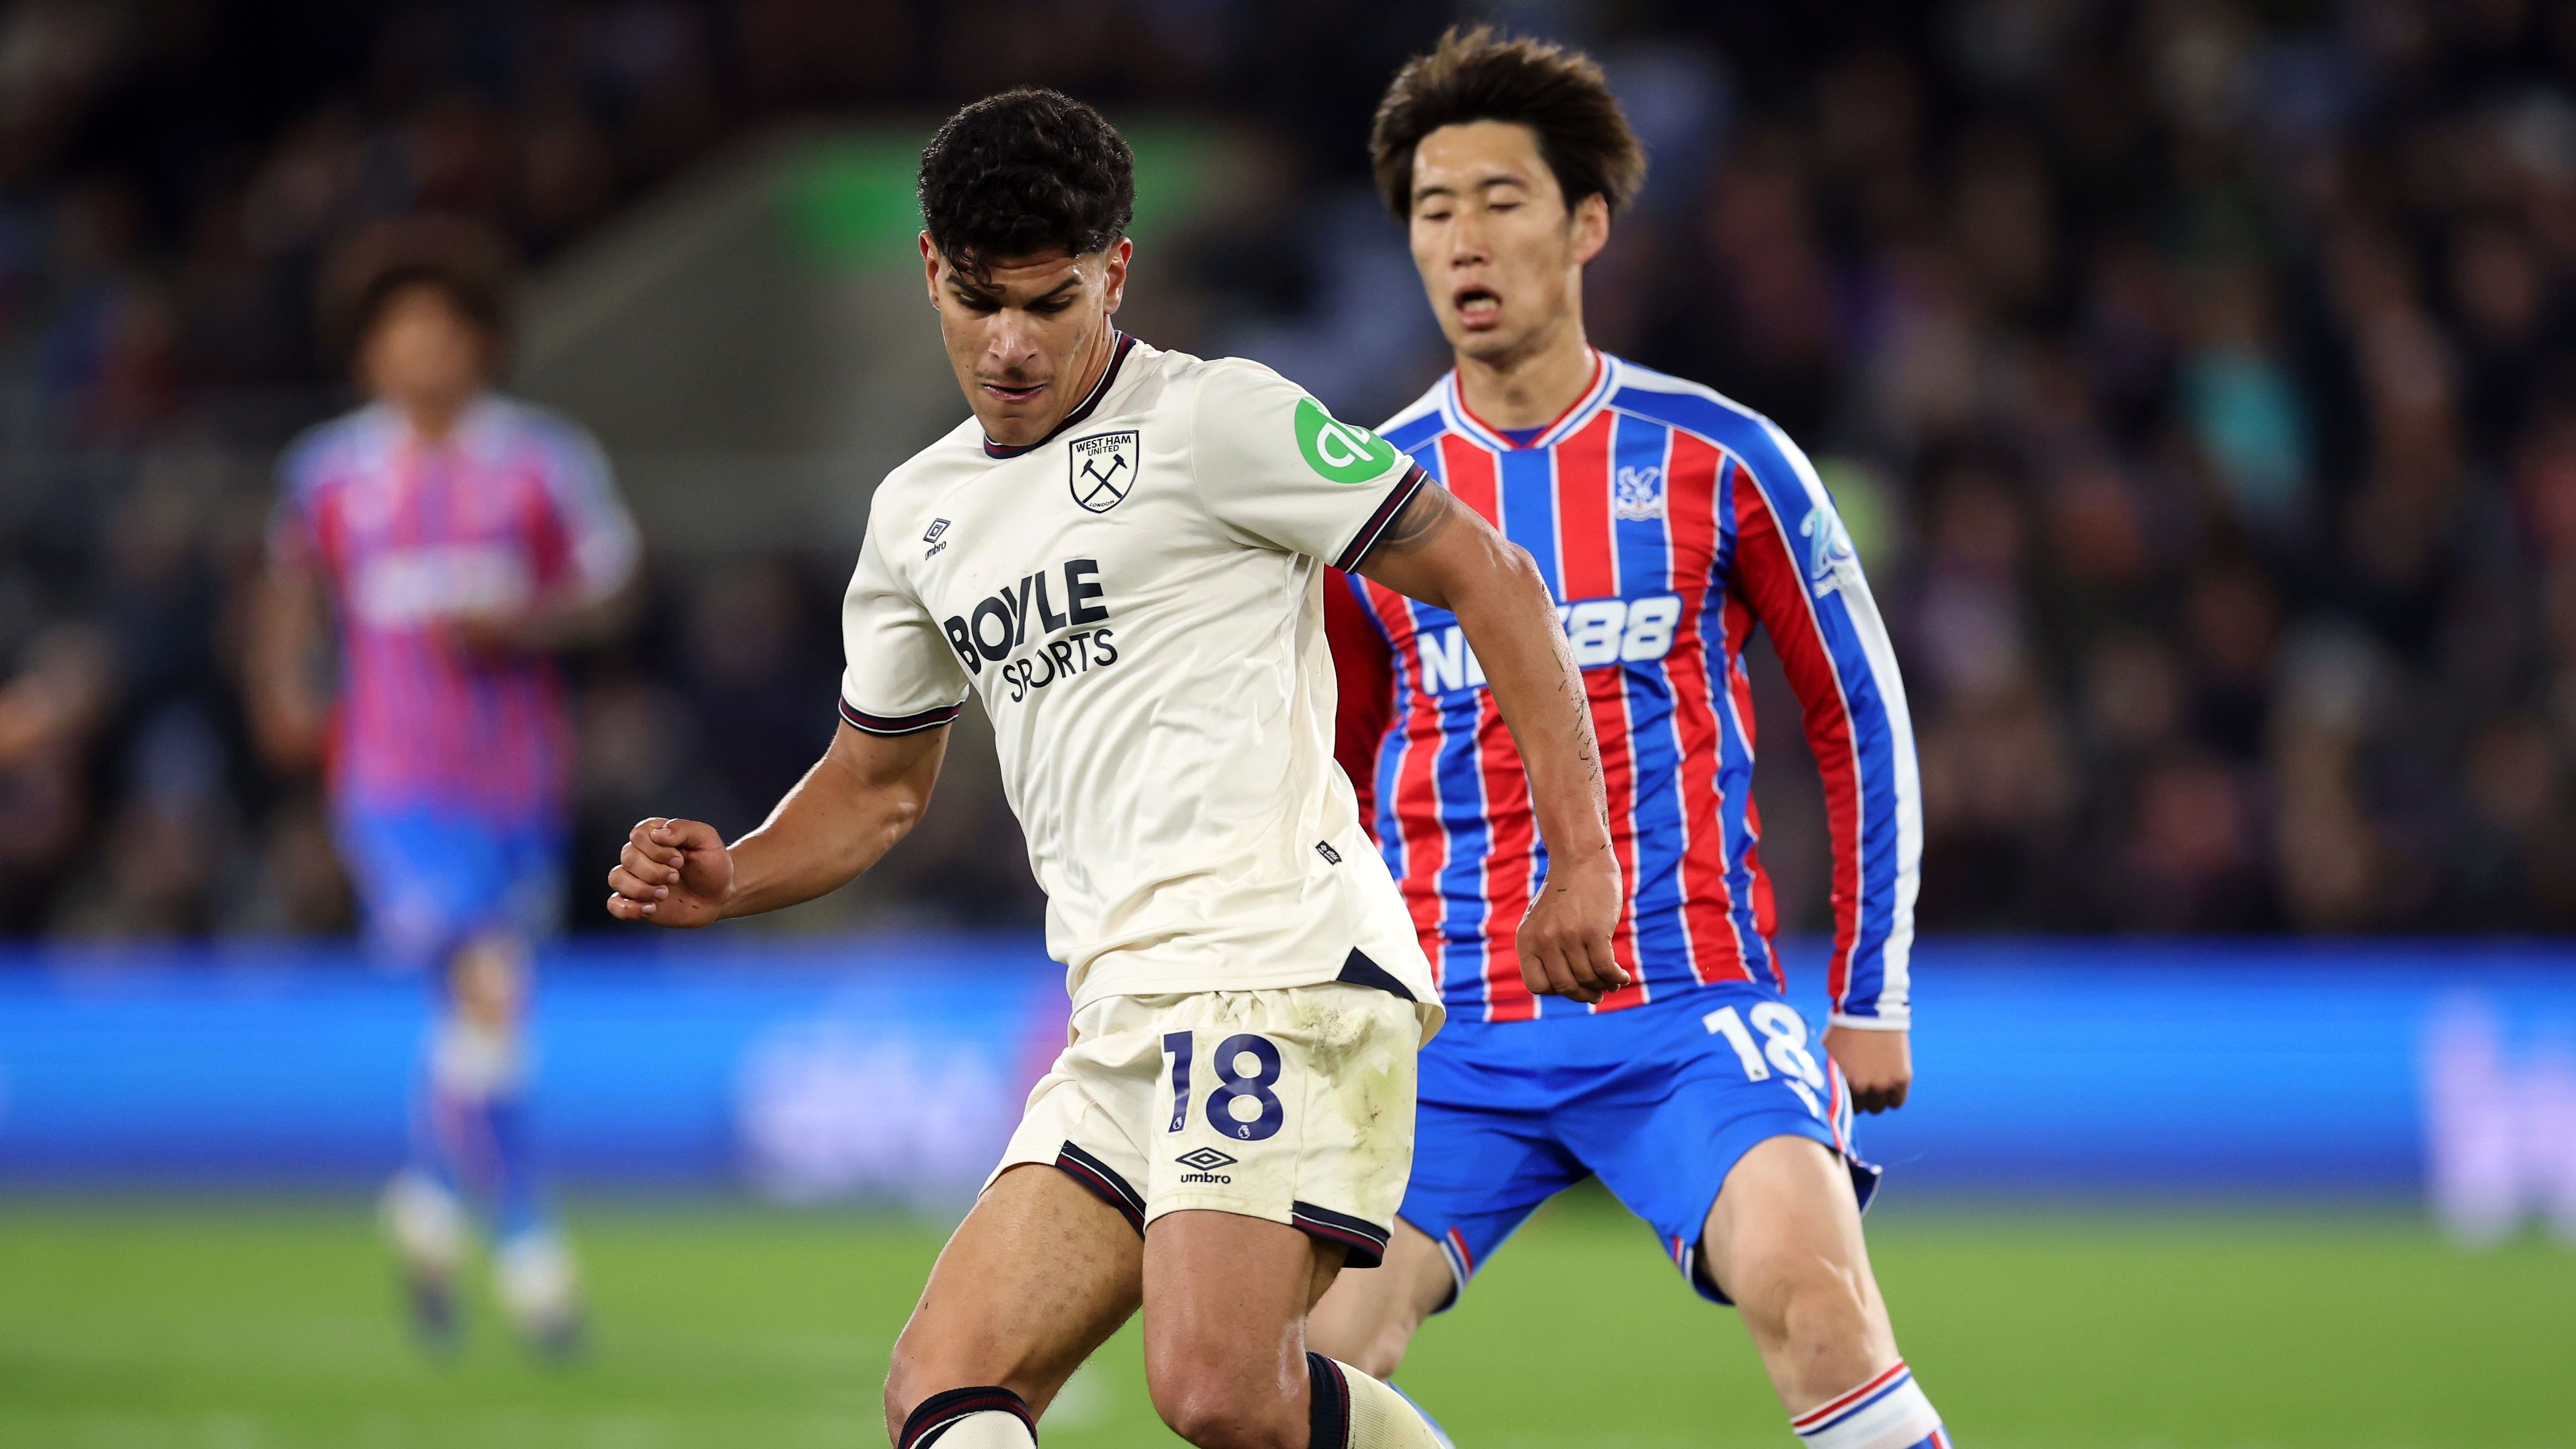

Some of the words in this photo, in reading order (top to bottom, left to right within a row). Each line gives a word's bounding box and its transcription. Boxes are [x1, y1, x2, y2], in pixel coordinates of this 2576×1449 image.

[1076, 438, 1103, 452] WEST
[1106, 435, 1131, 445] HAM
[1088, 445, 1119, 456] UNITED
[925, 540, 947, 561] umbro
[944, 559, 1109, 675] BOYLE
[1417, 596, 1681, 695] N88
[1003, 628, 1118, 702] SPORTS
[1701, 1001, 1825, 1089] 18
[1163, 1030, 1283, 1141] 18
[1180, 1173, 1231, 1184] umbro
